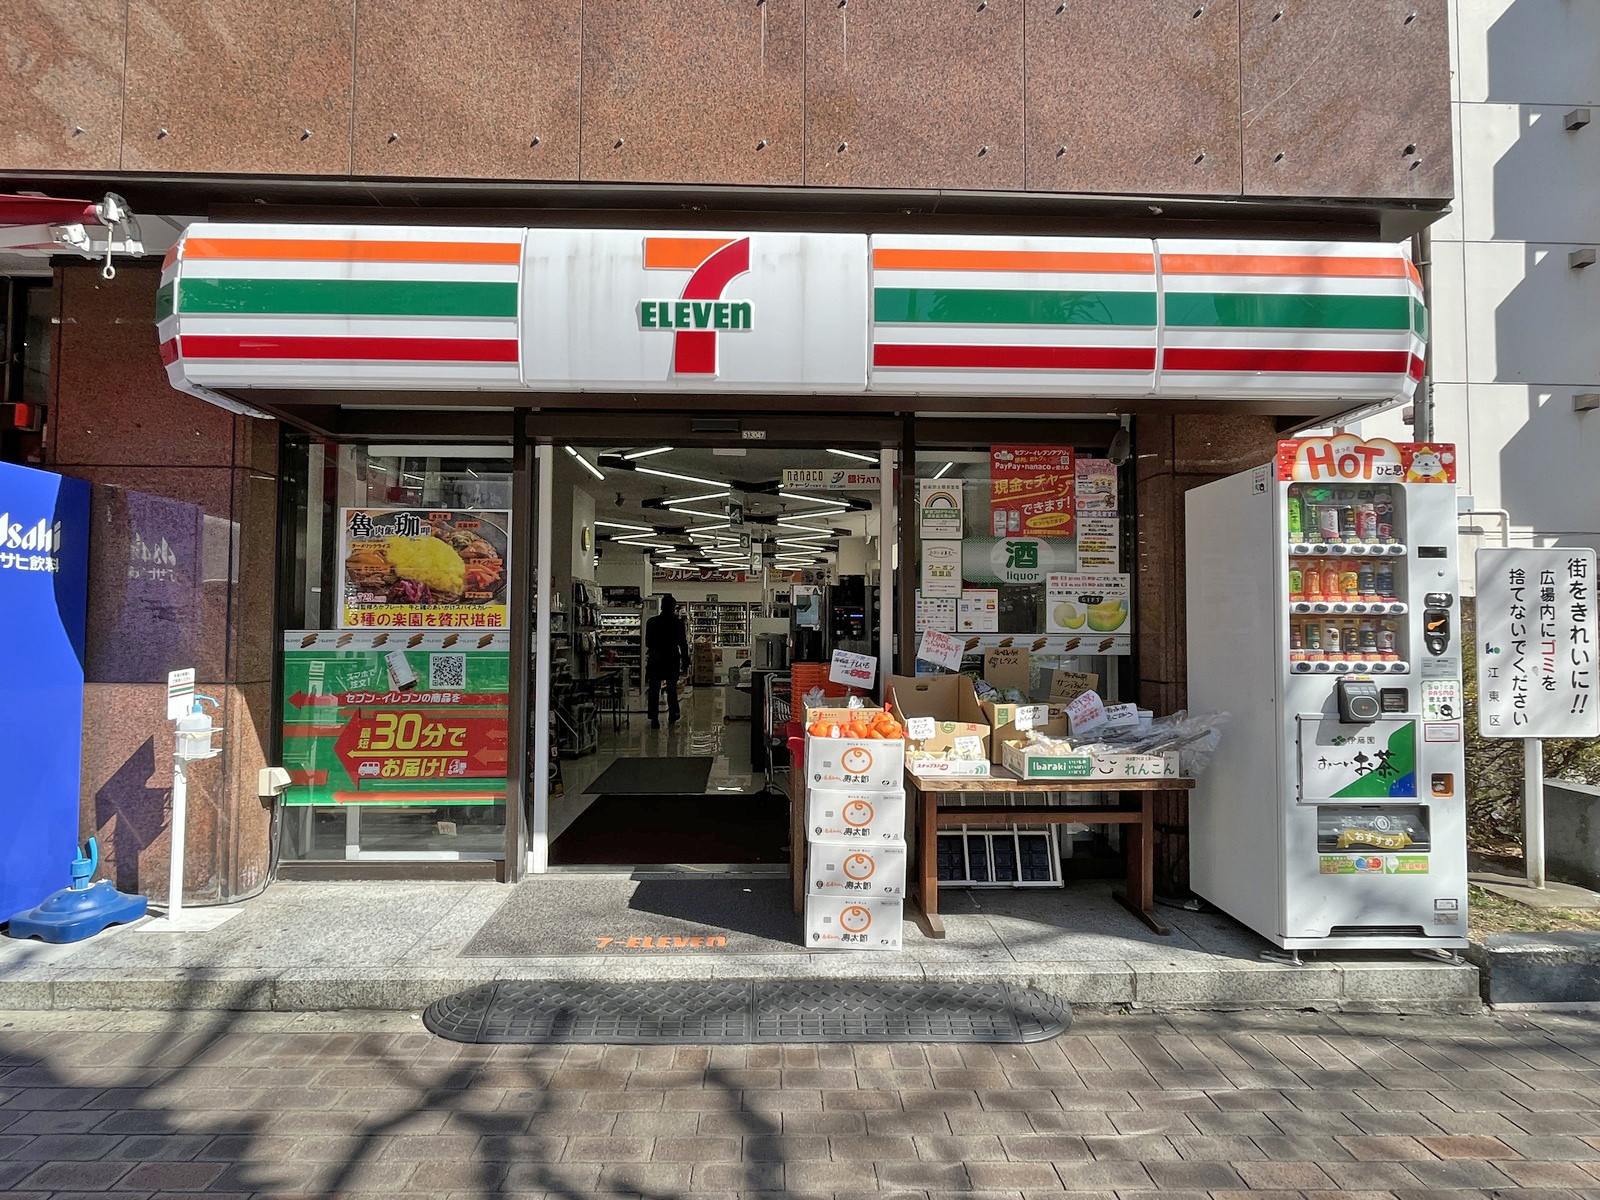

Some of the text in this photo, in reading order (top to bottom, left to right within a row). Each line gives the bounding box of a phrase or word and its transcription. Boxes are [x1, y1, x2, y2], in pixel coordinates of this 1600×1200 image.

[643, 236, 751, 374] 7
[787, 470, 823, 481] nanaco
[1376, 464, 1405, 476] ひと息
[740, 535, 749, 548] 3
[753, 555, 760, 565] 2
[1005, 540, 1039, 569] 酒
[1006, 570, 1040, 582] liquor
[349, 611, 502, 627] 3種の楽園を贅沢堪能
[1540, 570, 1556, 691] 広場内にゴミを
[1509, 568, 1529, 726] 捨てないでください
[1488, 667, 1501, 726] 江東区
[357, 713, 467, 750] 最短 30分で
[1347, 735, 1376, 745] 伊藤園
[381, 758, 448, 777] お届け!
[1033, 761, 1066, 771] Ibaraki
[1124, 763, 1175, 776] れんこん
[1355, 831, 1395, 847] おすすめ
